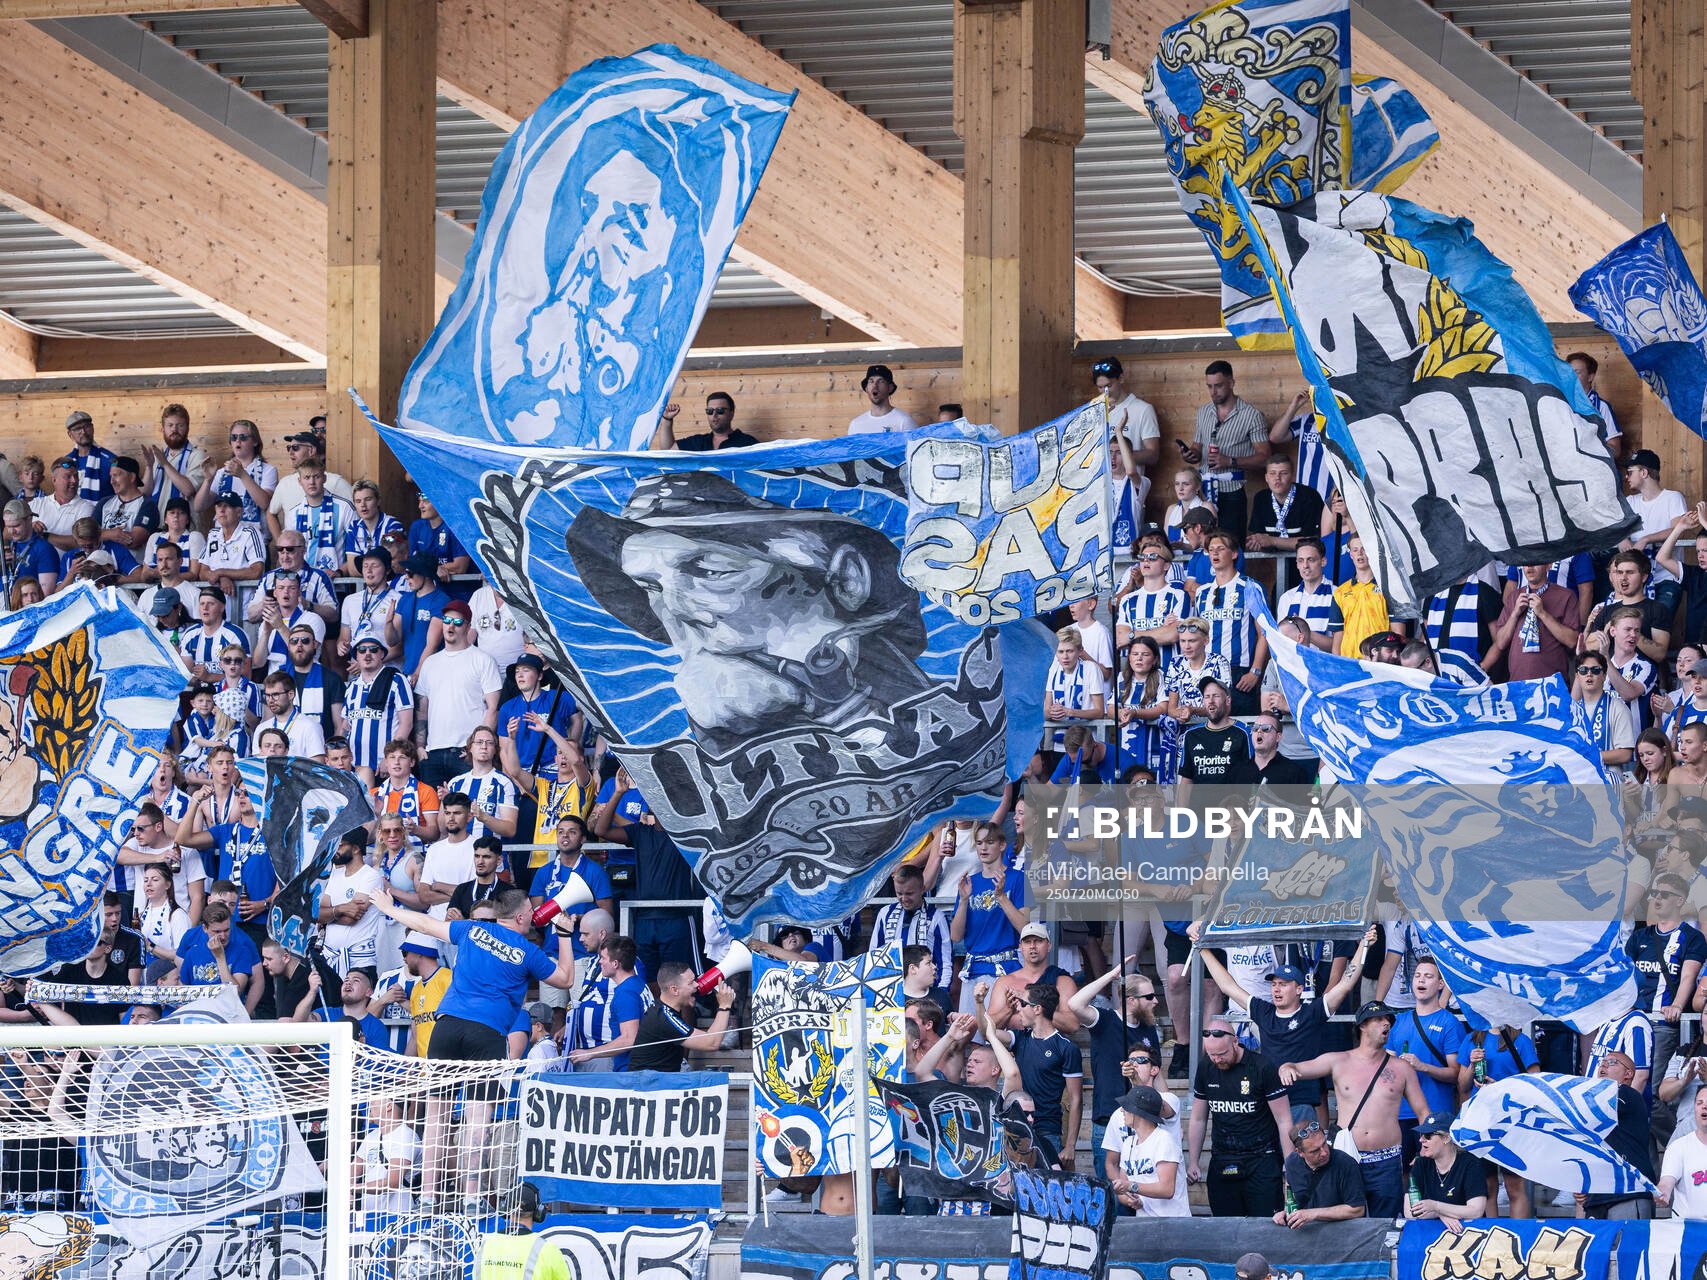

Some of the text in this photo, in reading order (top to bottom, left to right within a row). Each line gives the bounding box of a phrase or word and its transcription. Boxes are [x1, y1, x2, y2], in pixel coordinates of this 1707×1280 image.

[963, 739, 1006, 777] 202
[1194, 755, 1231, 766] Prioritet
[1198, 766, 1226, 775] Finans
[0, 727, 160, 905] NGRE
[809, 795, 851, 820] 20
[469, 926, 526, 964] ULTRAS
[387, 1005, 411, 1018] SERN
[752, 1013, 831, 1043] SUPRAS
[527, 1088, 722, 1138] SYMPATI FÖR
[1208, 1100, 1256, 1113] SERNEKE
[525, 1138, 717, 1181] DE AVSTÄNGDA
